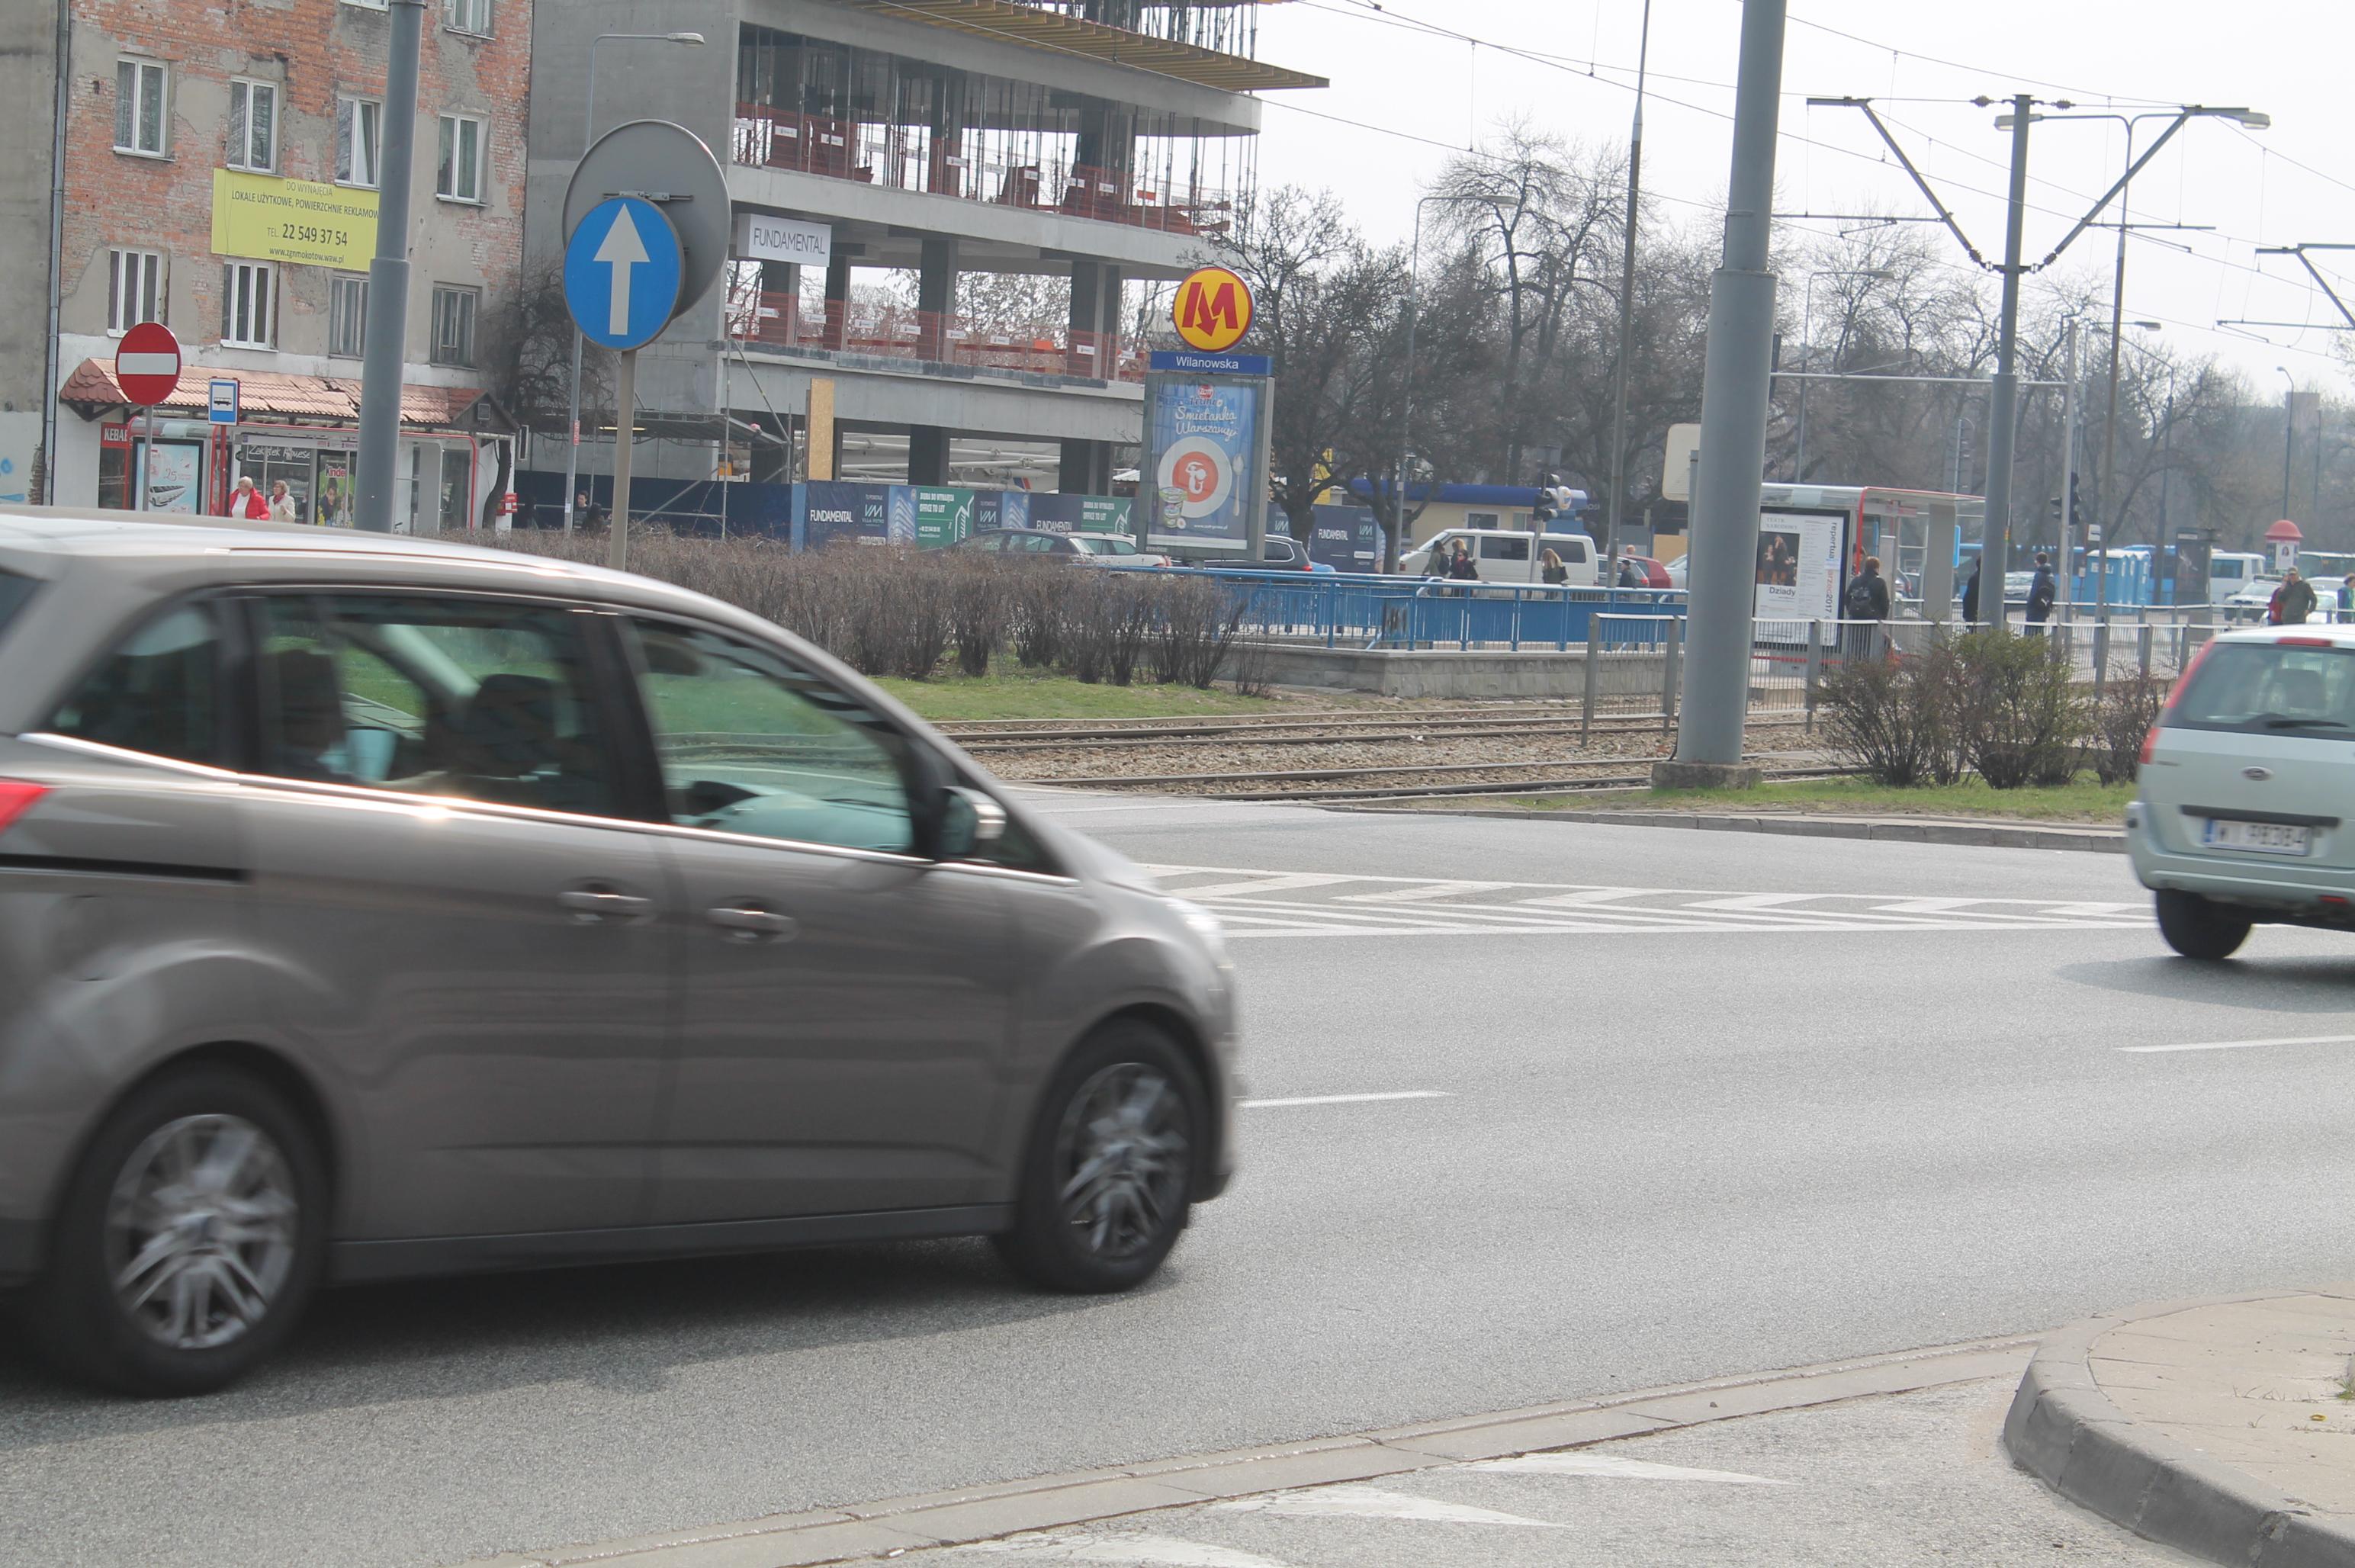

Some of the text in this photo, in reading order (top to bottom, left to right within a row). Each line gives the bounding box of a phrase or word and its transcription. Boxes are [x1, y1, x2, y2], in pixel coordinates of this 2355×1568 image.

[286, 181, 333, 198] DO WYNAJĘCIA
[231, 190, 379, 219] LOKALE UŻYTKOWE, POWIERZCHNIE REKLAMOW
[267, 223, 348, 246] TEL. 22 549 37 54
[753, 227, 825, 255] FUNDAMENTAL
[269, 248, 344, 264] www.zgnmokotow.waw.pl
[1176, 356, 1239, 370] Wilanowska
[810, 509, 853, 523] FUNDAMENTAL
[1318, 529, 1349, 541] FUNDAMENTAL
[1769, 586, 1796, 596] Dziady
